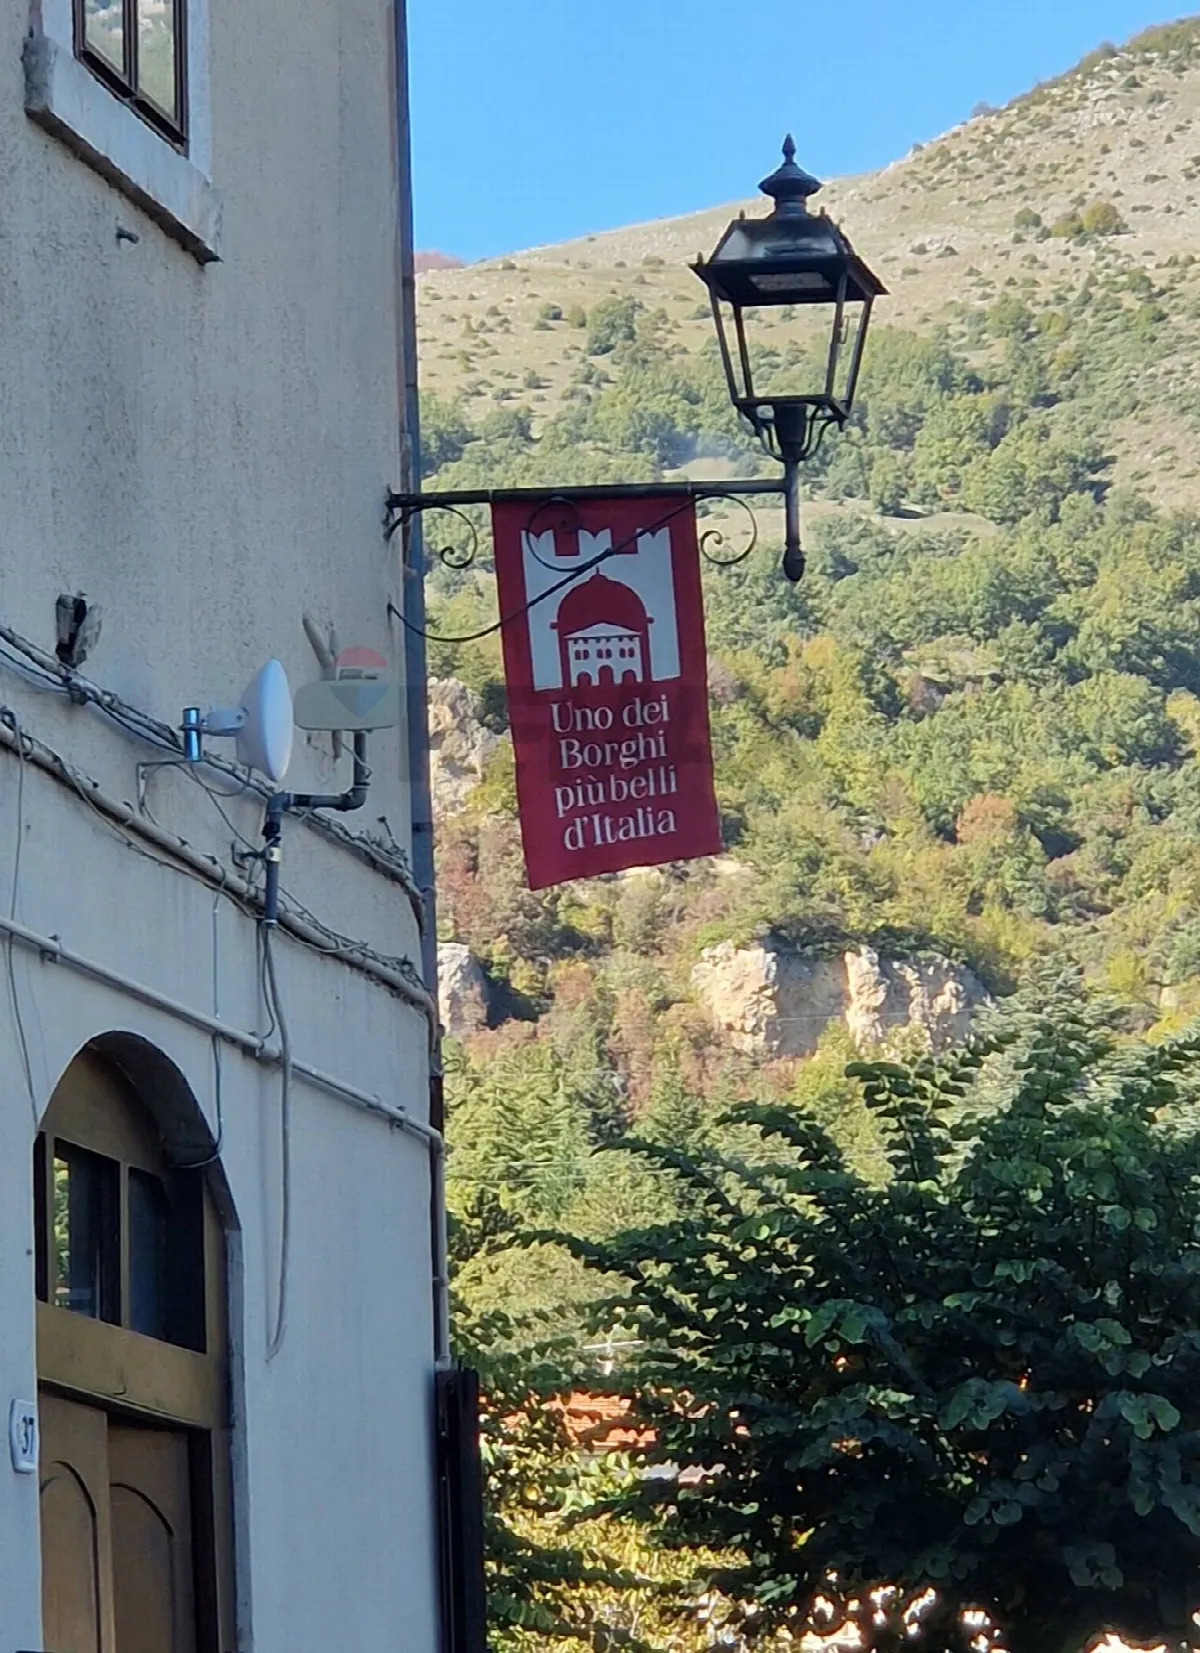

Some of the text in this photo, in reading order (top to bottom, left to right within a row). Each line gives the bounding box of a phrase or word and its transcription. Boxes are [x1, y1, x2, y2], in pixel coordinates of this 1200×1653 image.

[551, 694, 669, 733] Uno dei
[559, 730, 668, 770] Borghi
[563, 806, 677, 851] d'Italia
